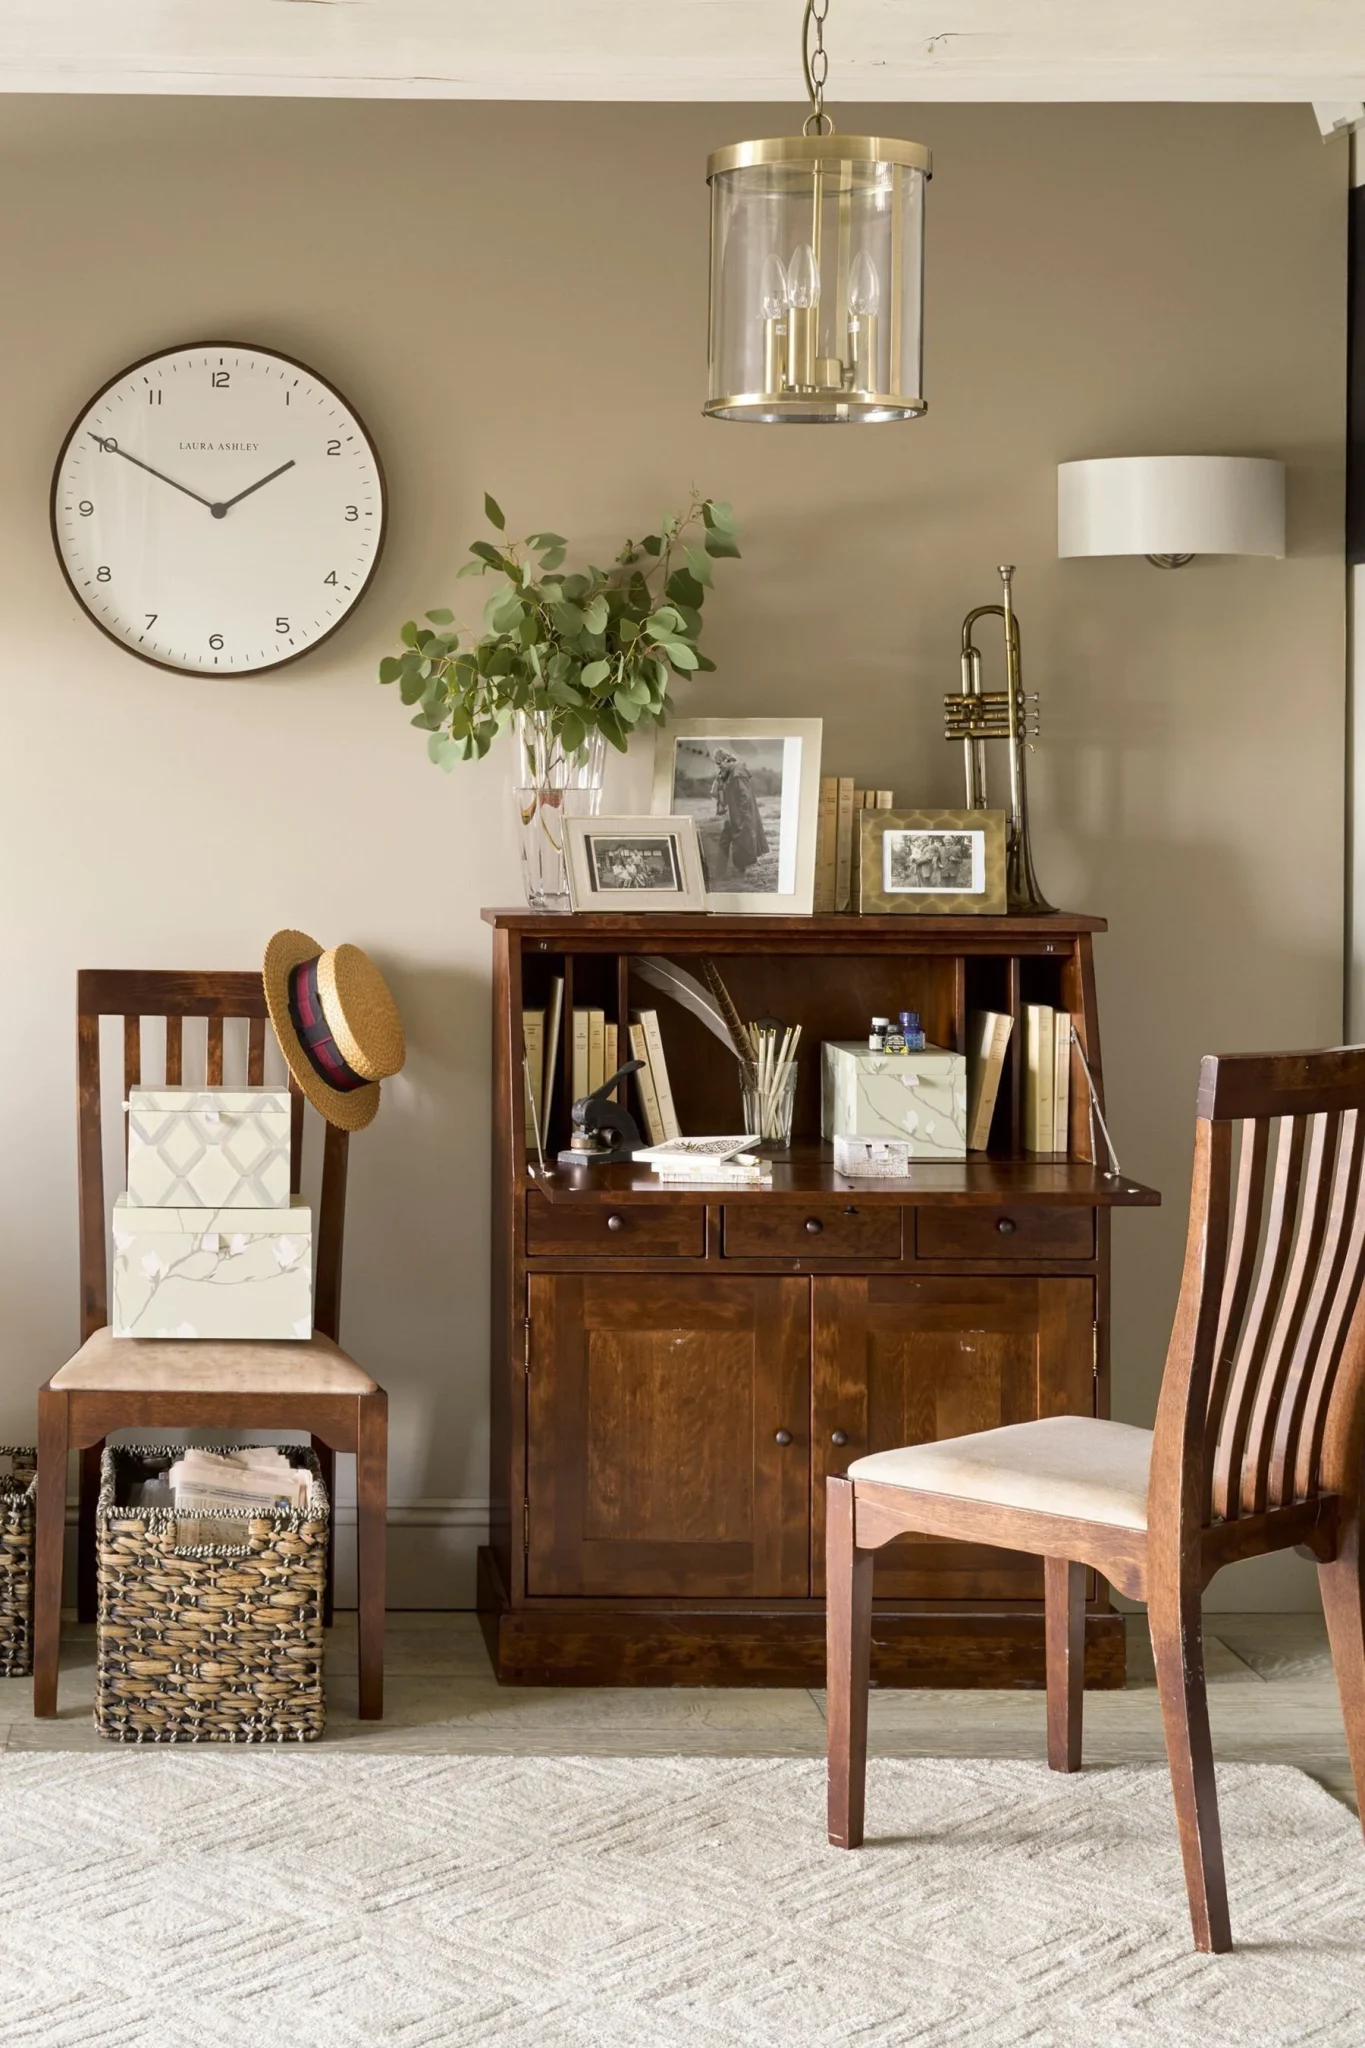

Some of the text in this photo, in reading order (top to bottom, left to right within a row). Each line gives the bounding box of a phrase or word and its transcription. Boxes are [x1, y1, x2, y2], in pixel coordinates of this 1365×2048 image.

[212, 372, 230, 388] 12
[149, 390, 162, 405] 11
[286, 391, 290, 406] 1
[98, 437, 118, 453] 10
[179, 442, 259, 451] LAURA ASHLEY
[327, 440, 341, 456] 2
[79, 500, 93, 517] 9
[345, 505, 359, 522] 3
[96, 566, 112, 582] 8
[323, 571, 338, 586] 4
[144, 615, 158, 630] 7
[275, 617, 290, 634] 5
[209, 634, 224, 650] 6
